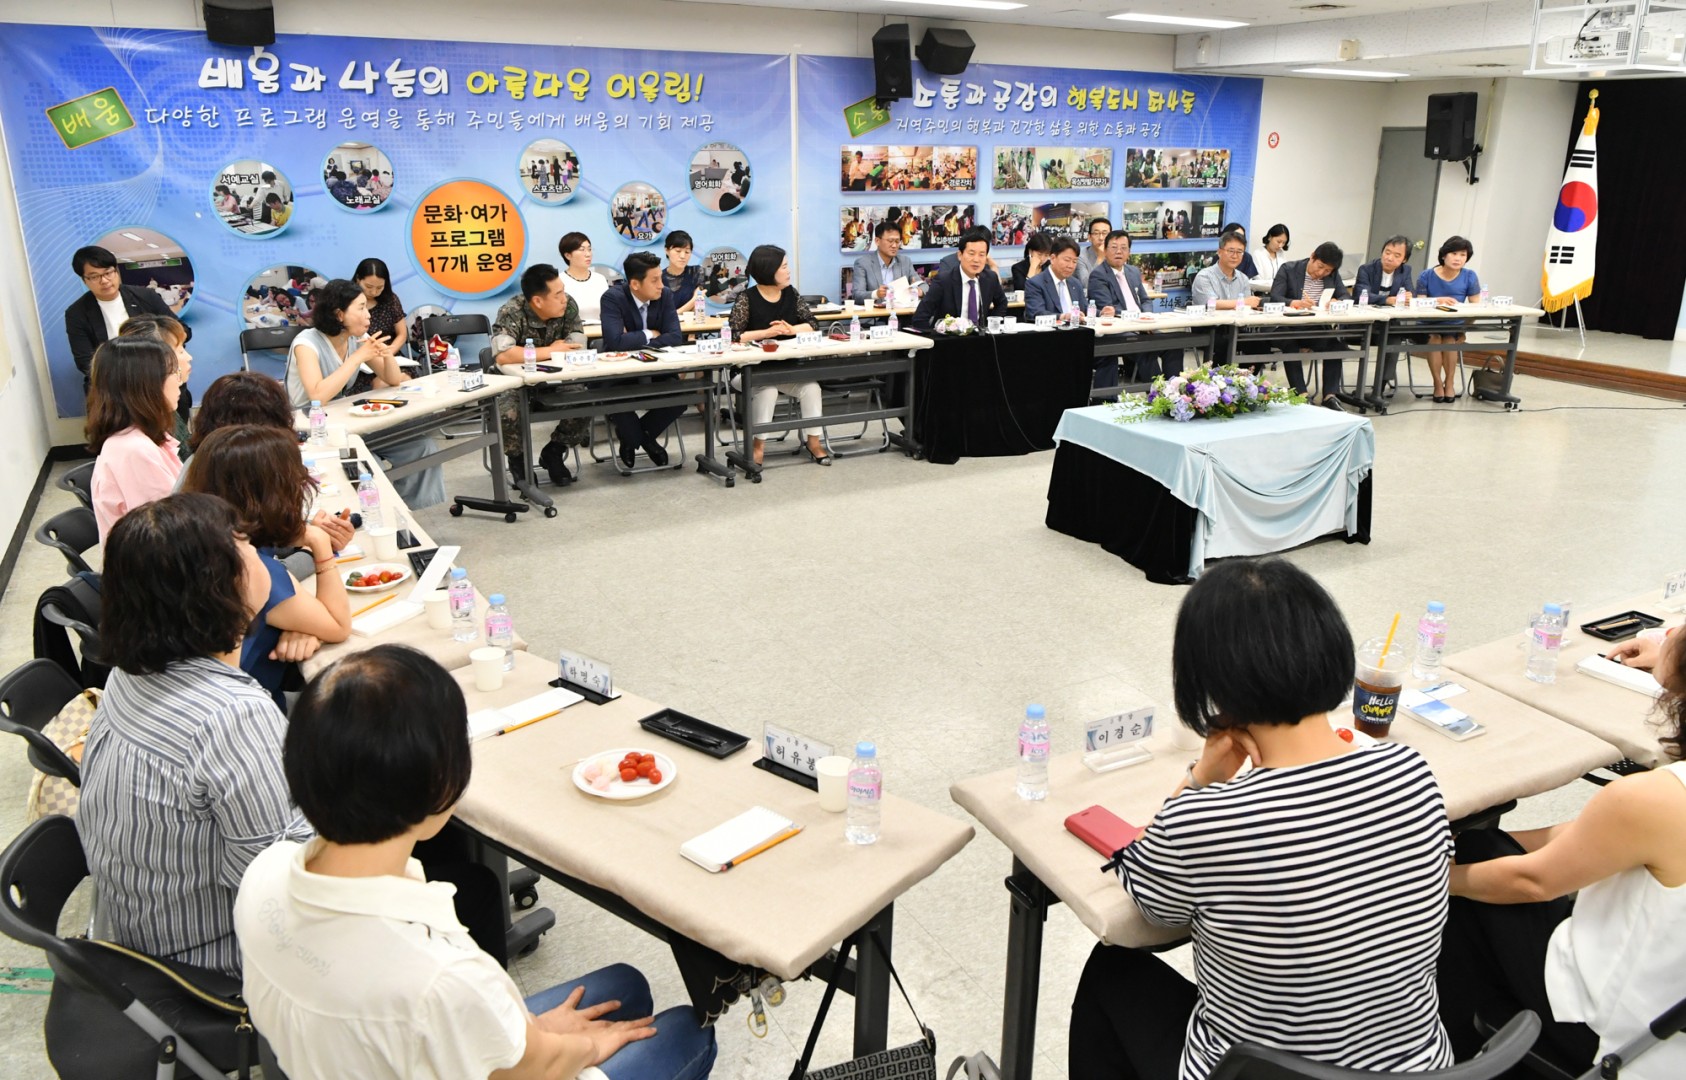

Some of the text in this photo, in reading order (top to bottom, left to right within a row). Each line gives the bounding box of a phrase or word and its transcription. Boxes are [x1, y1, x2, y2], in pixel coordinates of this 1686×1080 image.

[198, 46, 705, 103] 배움과 나눔의 아름다운 어울림!
[913, 77, 987, 111] 소통과
[993, 79, 1058, 113] 공감의
[1066, 84, 1138, 111] 행복도시
[62, 97, 120, 135] 배움
[144, 104, 715, 132] 다양한 프로그램 운영을 통해 주민들에게 배움의 기회 제공
[895, 117, 963, 134] 지역주민의
[966, 116, 1006, 135] 행복과
[1010, 119, 1046, 135] 건강한
[1049, 120, 1073, 137] 삶을
[1077, 120, 1100, 137] 위한
[1103, 121, 1137, 138] 소통과
[221, 173, 260, 186] 서예교실
[532, 184, 572, 194] 스포츠댄스
[694, 179, 723, 190] 영어회화
[949, 177, 973, 187] 경로잔치
[345, 194, 381, 205] 노래교실
[423, 203, 508, 224] 문화·여가
[430, 228, 506, 248] 프로그램
[637, 232, 653, 241] 요가
[427, 252, 513, 274] 17개 운영
[1159, 296, 1182, 309] 좌4동
[1098, 722, 1142, 744] 이경순
[776, 745, 816, 771] 허유봉
